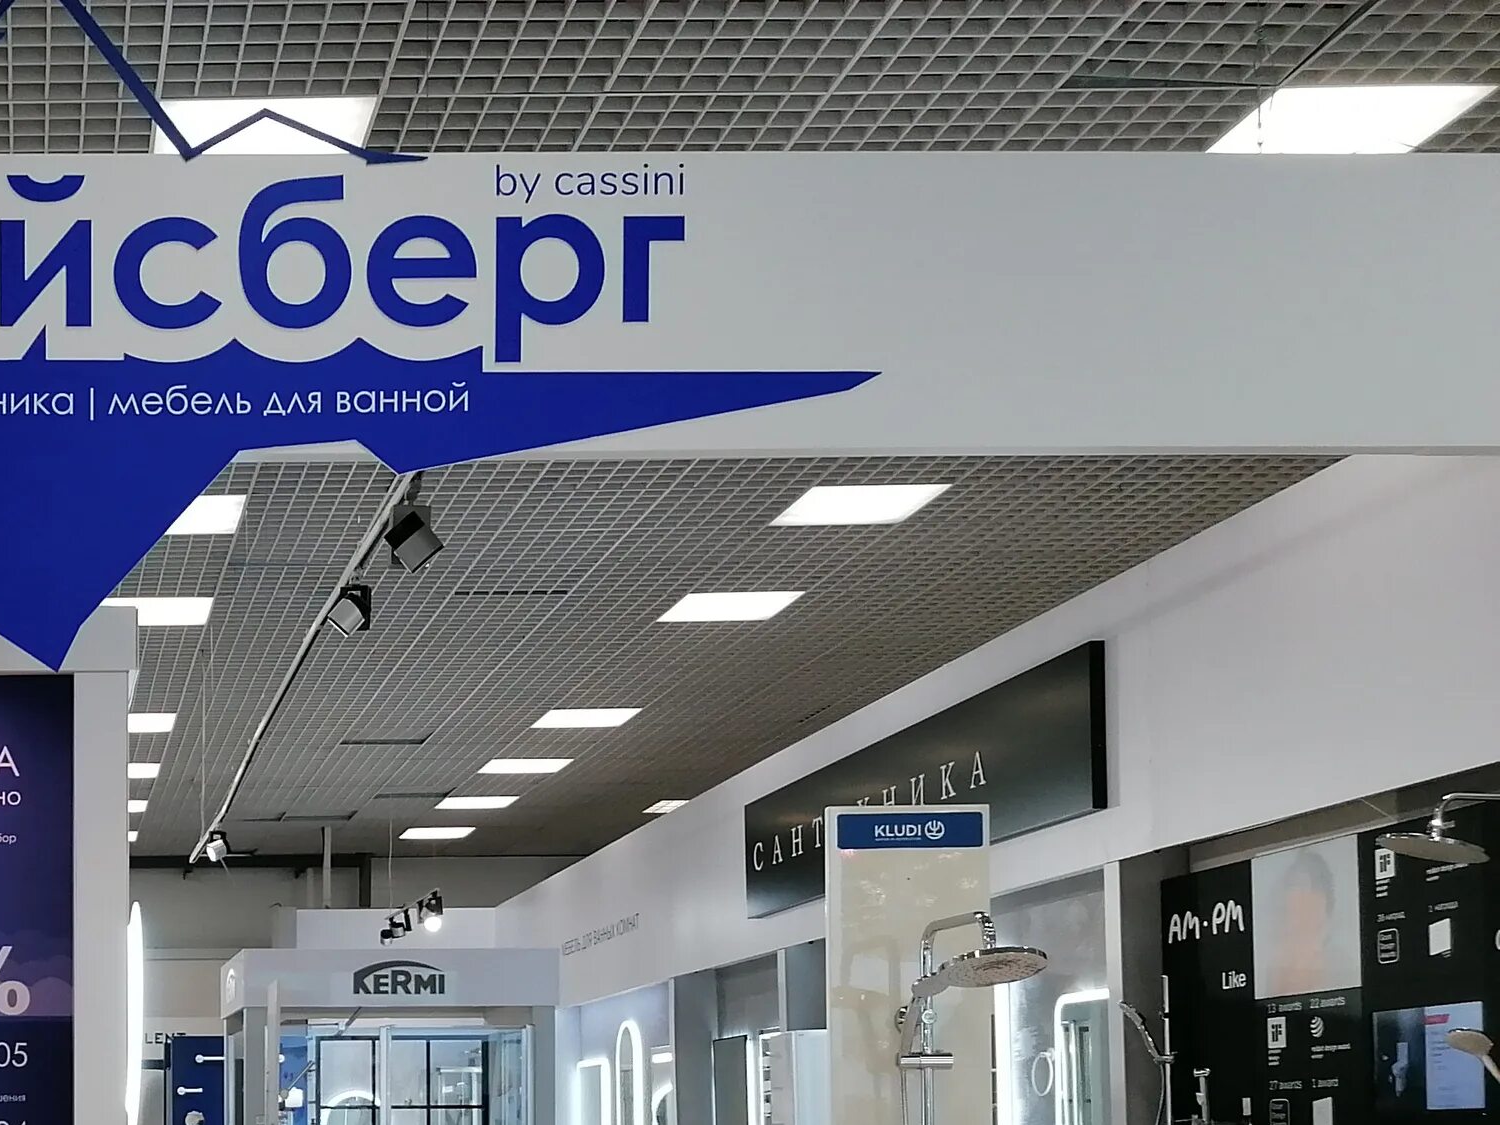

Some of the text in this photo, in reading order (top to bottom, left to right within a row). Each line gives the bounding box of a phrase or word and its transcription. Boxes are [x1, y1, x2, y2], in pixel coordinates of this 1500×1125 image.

[496, 163, 685, 203] by cassini
[107, 384, 252, 416] мебель
[263, 390, 322, 417] для
[336, 381, 469, 414] ванной
[752, 750, 987, 871] САНТНИКА
[874, 824, 922, 838] KLUDI
[352, 960, 446, 995] KERMI
[1221, 970, 1247, 991] Like
